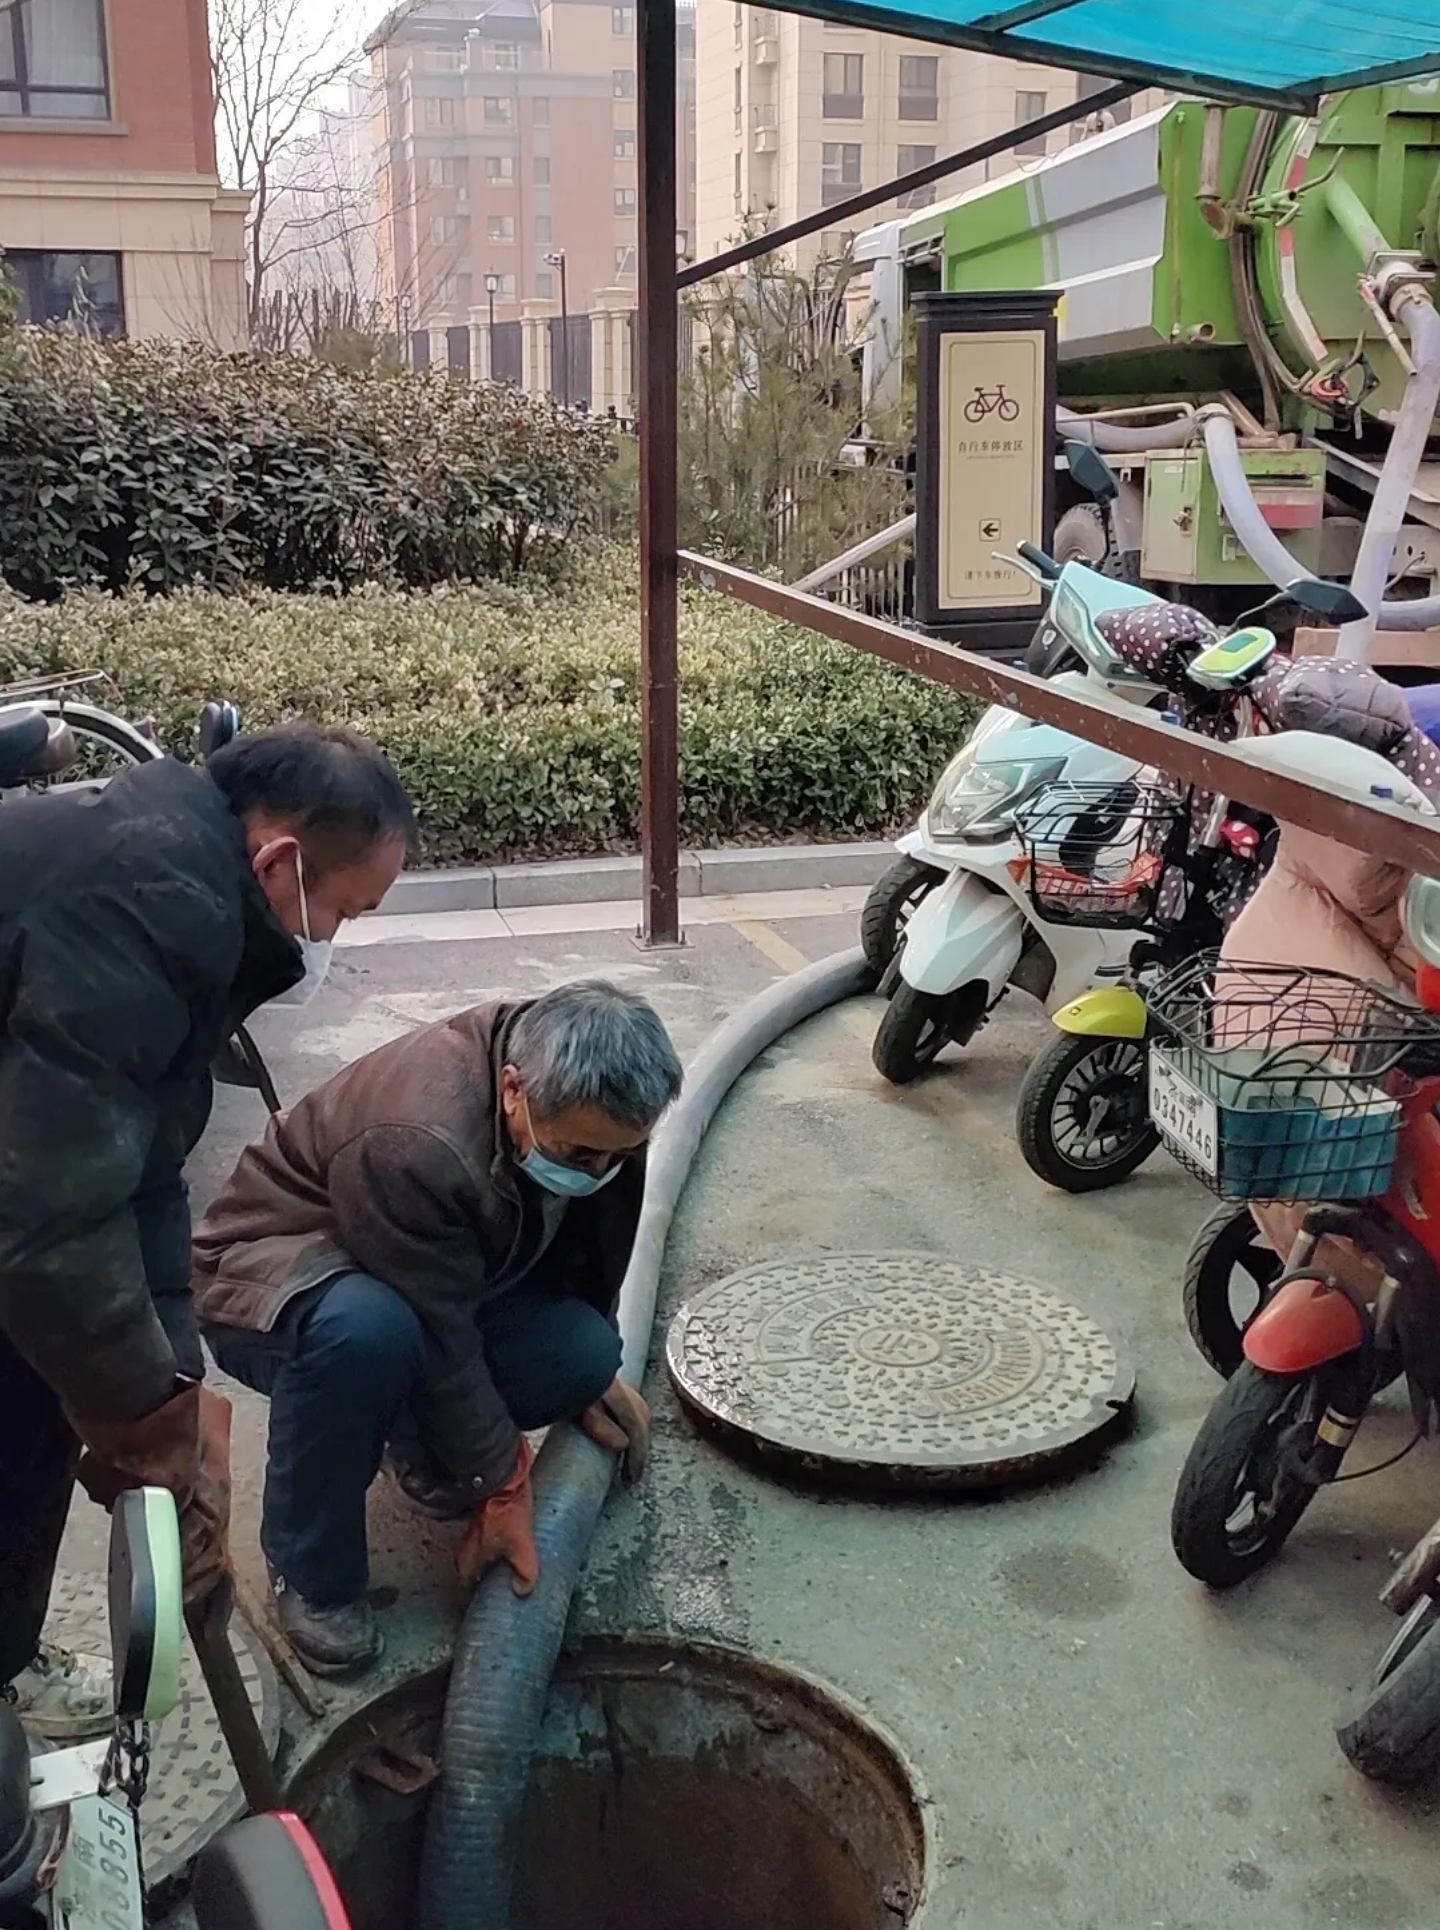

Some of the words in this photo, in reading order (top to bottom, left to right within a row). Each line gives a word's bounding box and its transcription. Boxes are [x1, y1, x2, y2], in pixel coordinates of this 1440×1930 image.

[958, 440, 1023, 453] 自行车停放区
[1153, 1086, 1213, 1160] 0347446
